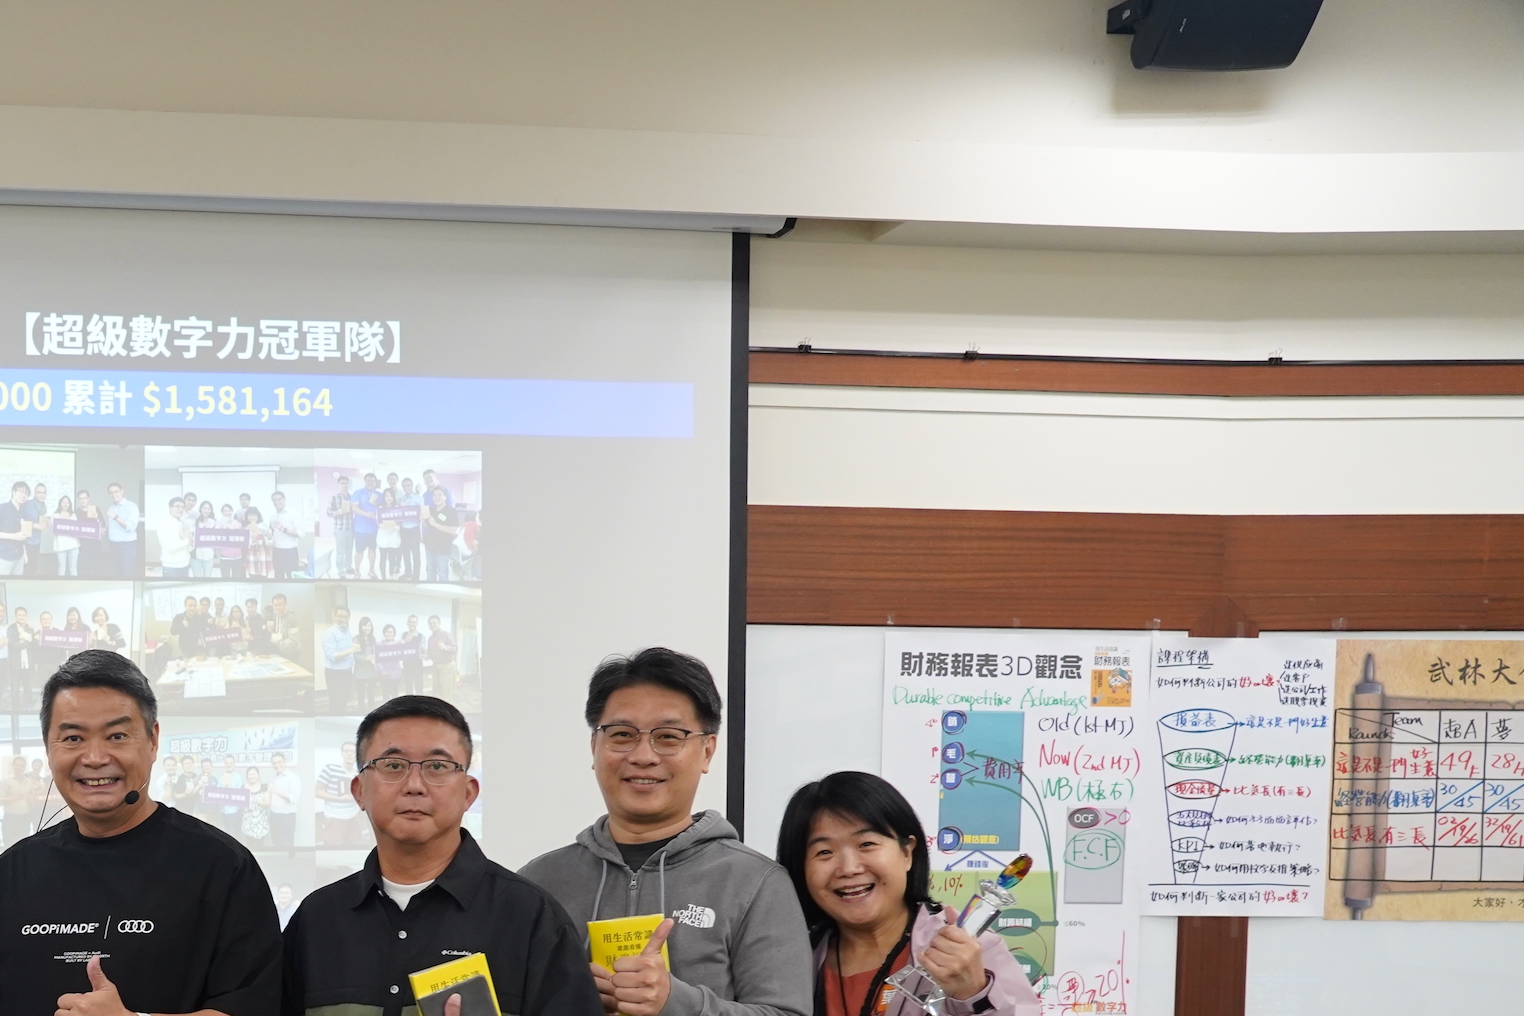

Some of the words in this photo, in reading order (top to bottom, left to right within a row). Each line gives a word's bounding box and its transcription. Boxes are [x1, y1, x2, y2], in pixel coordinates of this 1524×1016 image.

[25, 312, 401, 364] 【超級數字力冠軍隊】
[62, 380, 133, 416] 累計
[143, 380, 333, 423] $1,581,164
[900, 651, 1083, 680] 財務報表3D觀念
[1427, 657, 1524, 686] 武林大
[1038, 713, 1071, 732] Old
[1383, 712, 1424, 727] Team
[1039, 739, 1071, 768] Now
[1074, 813, 1094, 823] OCF
[672, 909, 703, 921] NORTH
[687, 904, 706, 913] THE
[678, 916, 702, 928] FACE
